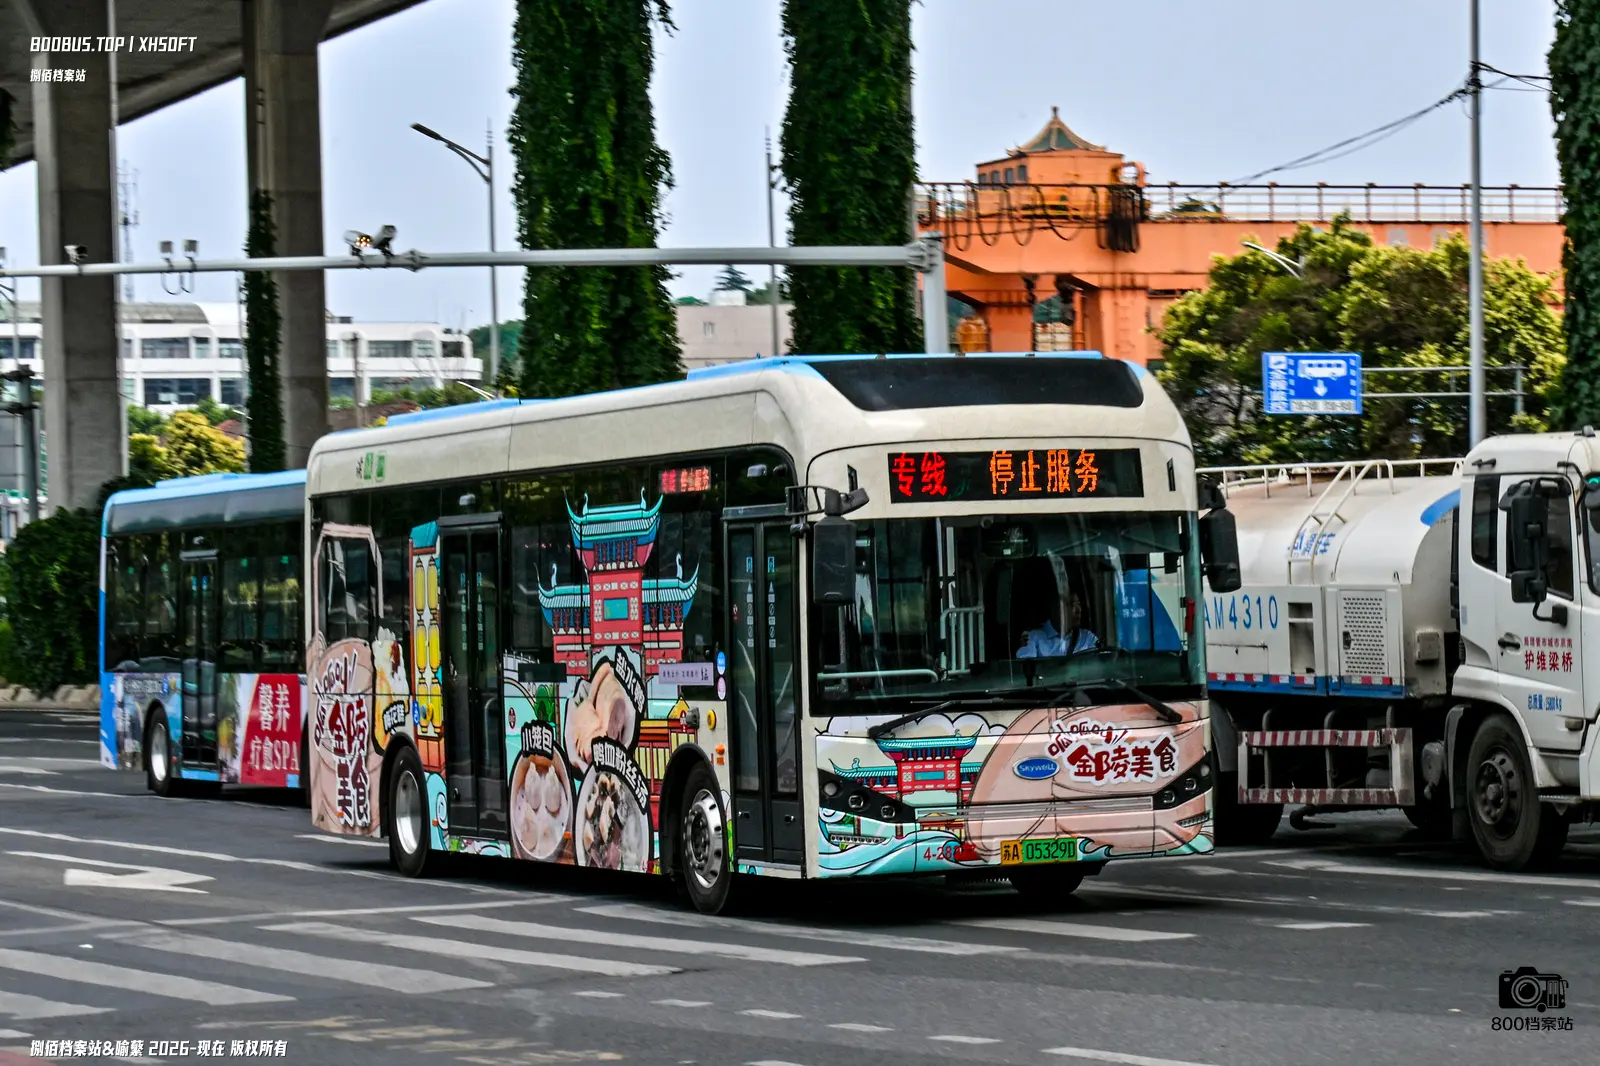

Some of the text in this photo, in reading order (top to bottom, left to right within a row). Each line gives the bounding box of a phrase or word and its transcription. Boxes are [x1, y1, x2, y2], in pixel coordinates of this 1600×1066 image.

[891, 449, 1099, 496] 专线 停止服务
[522, 725, 553, 754] 小笼包
[592, 741, 649, 809] 鸭血粉丝汤
[1003, 841, 1076, 864] 苏A 05329D
